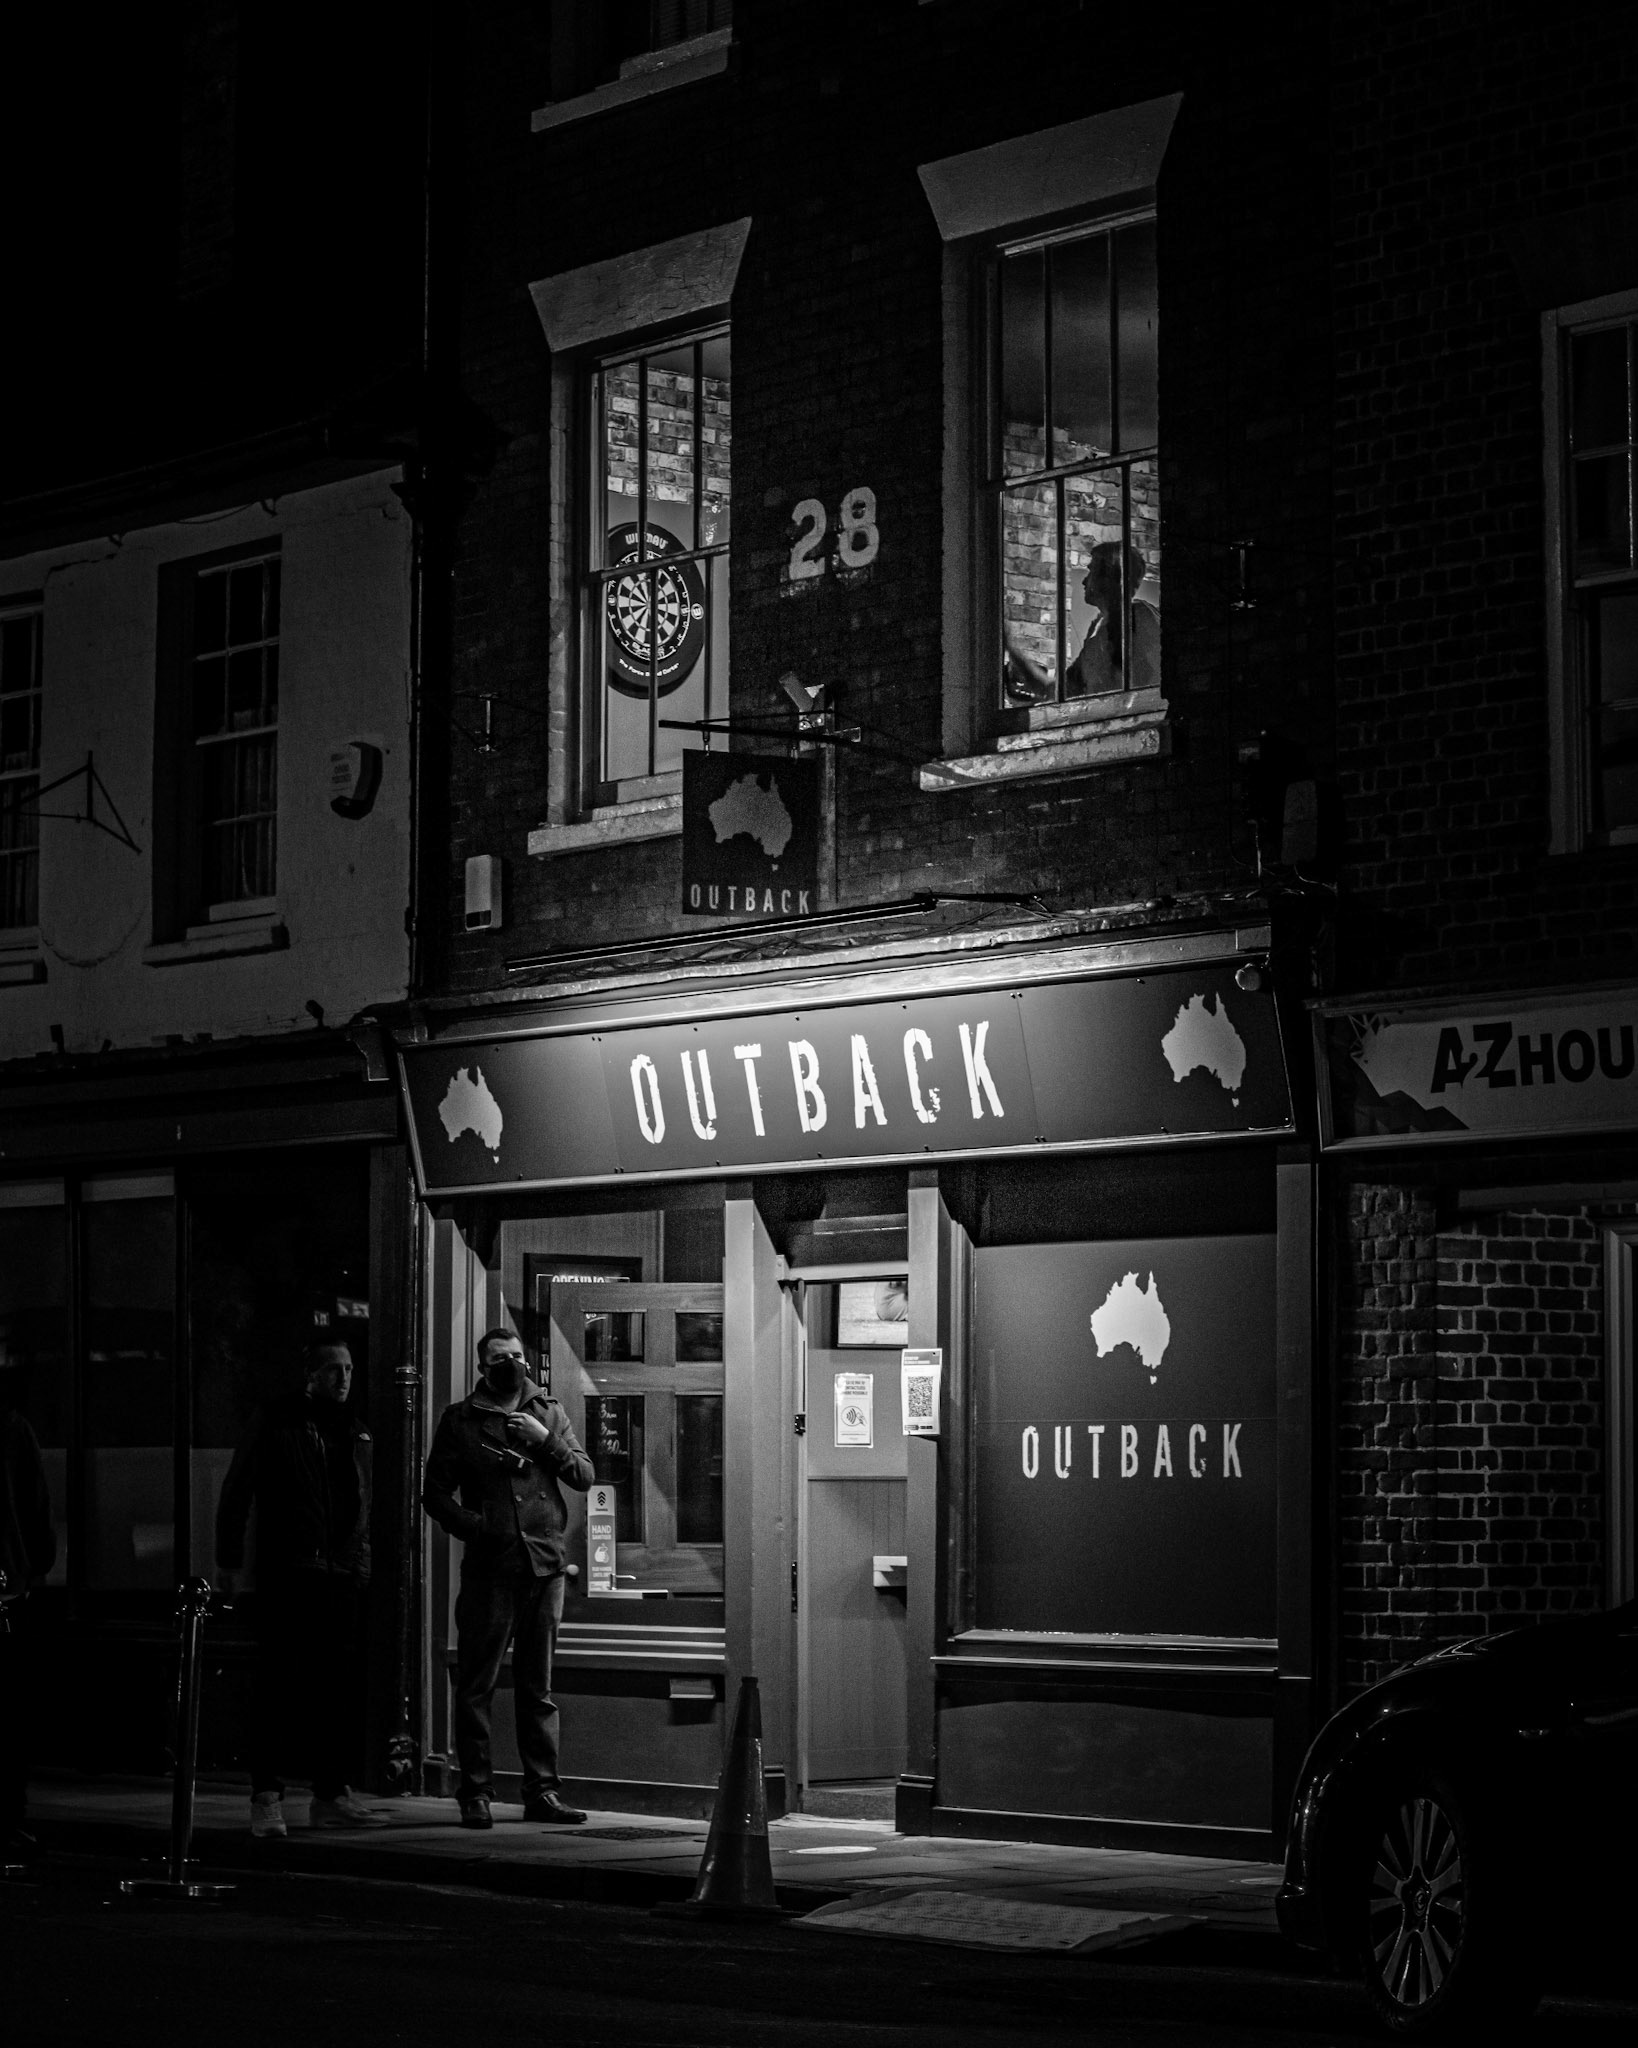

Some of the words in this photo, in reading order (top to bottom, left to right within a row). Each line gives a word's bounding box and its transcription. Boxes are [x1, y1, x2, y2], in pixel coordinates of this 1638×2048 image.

[788, 486, 879, 581] 28
[690, 883, 810, 915] OUTBACK
[629, 1020, 1005, 1145] OUTBACK
[1022, 1423, 1243, 1479] OUTBACK
[591, 1524, 612, 1534] HAND
